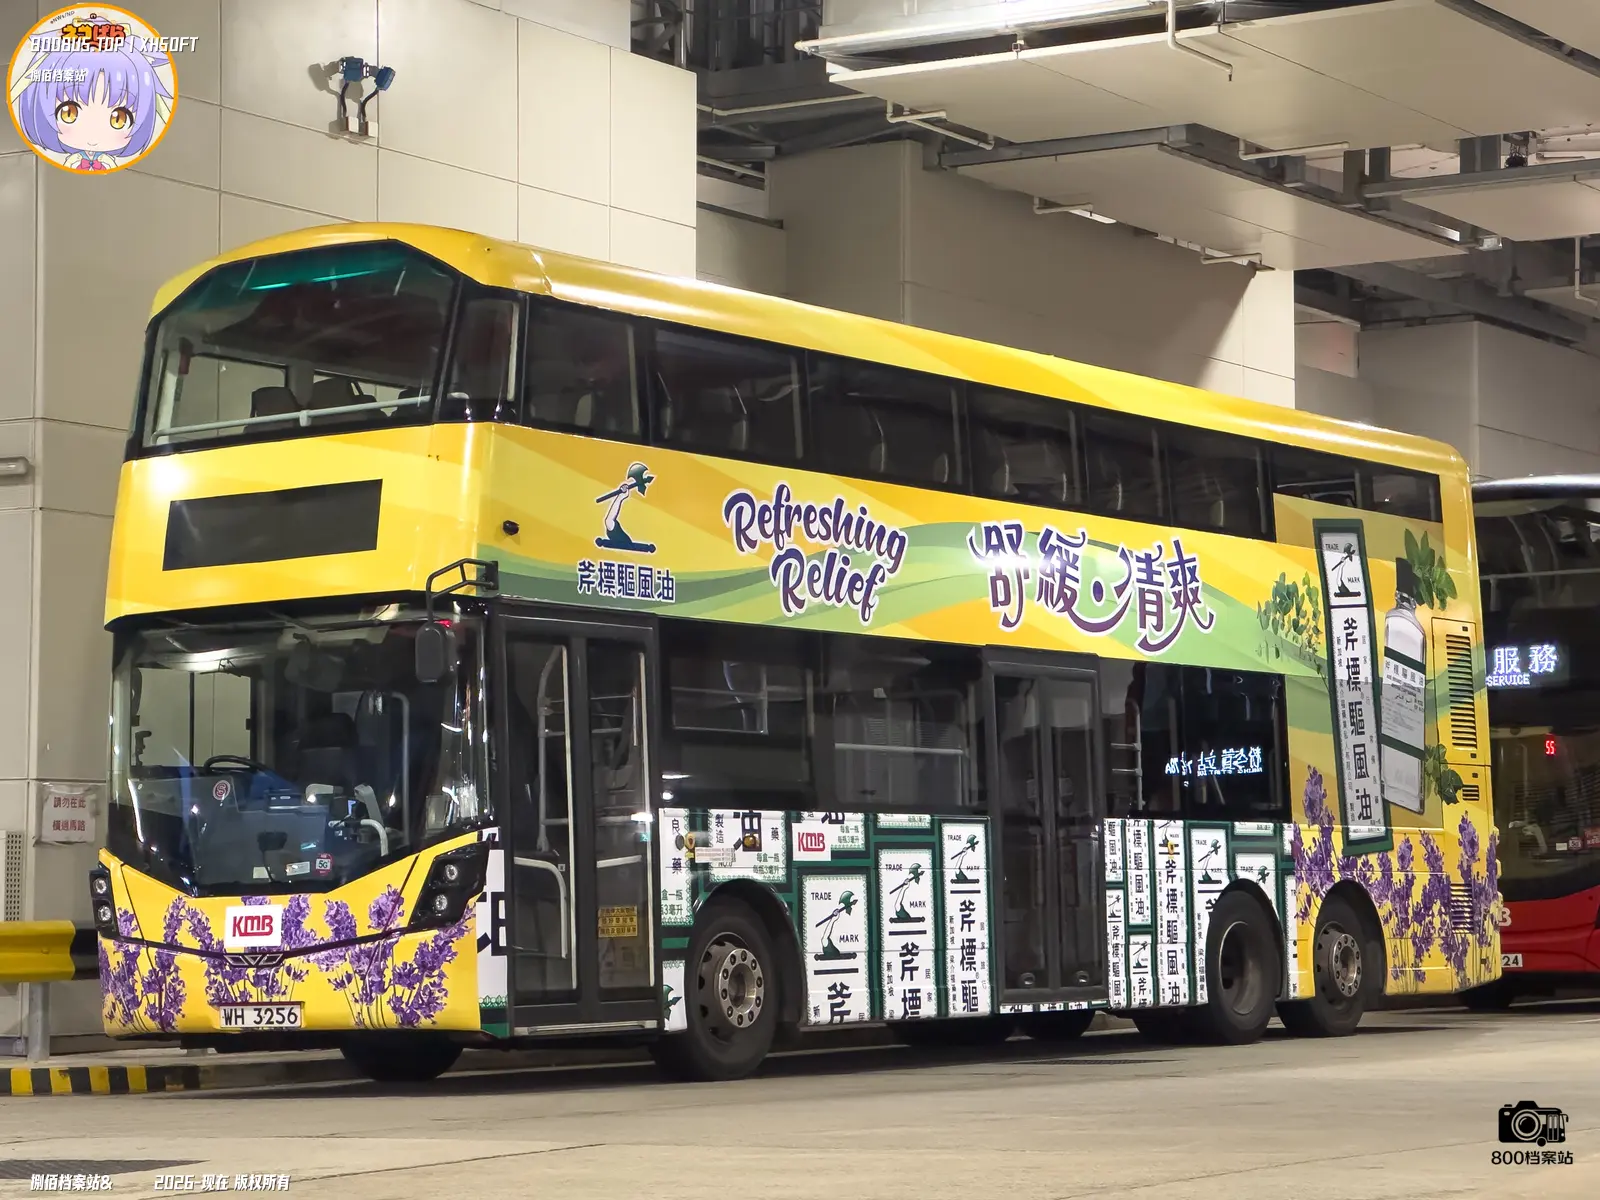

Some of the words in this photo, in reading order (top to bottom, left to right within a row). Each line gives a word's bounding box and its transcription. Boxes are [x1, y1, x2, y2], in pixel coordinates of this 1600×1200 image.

[724, 484, 906, 573] Refreshing
[577, 561, 675, 601] 斧標驅風油
[771, 550, 886, 622] Relief
[1493, 644, 1558, 674] 服務
[1485, 674, 1530, 686] SERVICE
[798, 832, 825, 852] KMB
[947, 834, 962, 842] TRADE
[885, 863, 903, 872] TRADE
[811, 892, 832, 901] TRADE
[909, 900, 927, 909] MARK
[232, 915, 274, 937] KMB
[839, 934, 860, 943] MARK
[223, 1008, 245, 1025] WH
[253, 1007, 298, 1025] 3256
